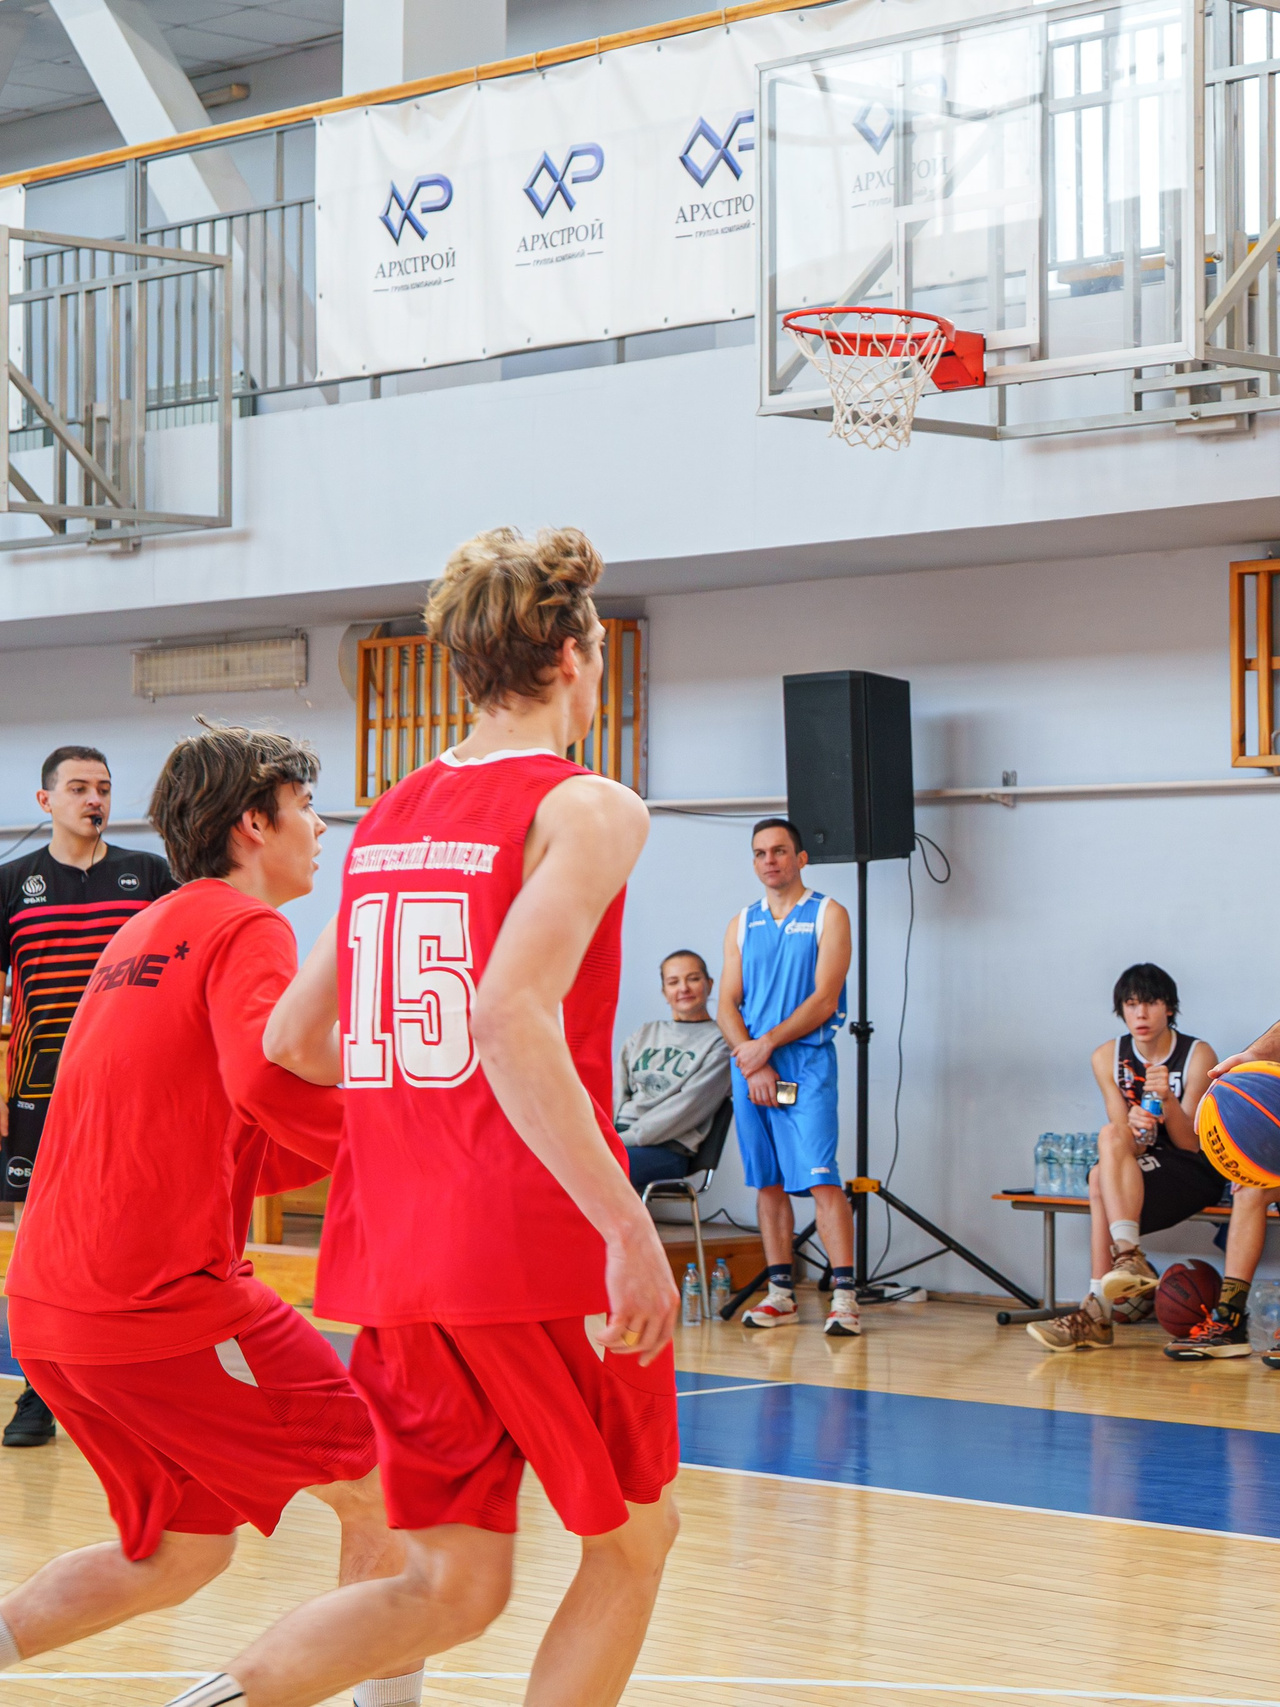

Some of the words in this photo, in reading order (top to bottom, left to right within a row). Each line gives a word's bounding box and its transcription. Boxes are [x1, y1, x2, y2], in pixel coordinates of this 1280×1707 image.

[675, 194, 755, 224] АРХСТРО
[516, 218, 604, 252] АРХСТРОЙ
[374, 247, 456, 279] АРХСТРОЙ
[343, 892, 480, 1088] 15
[632, 1047, 696, 1078] NYC
